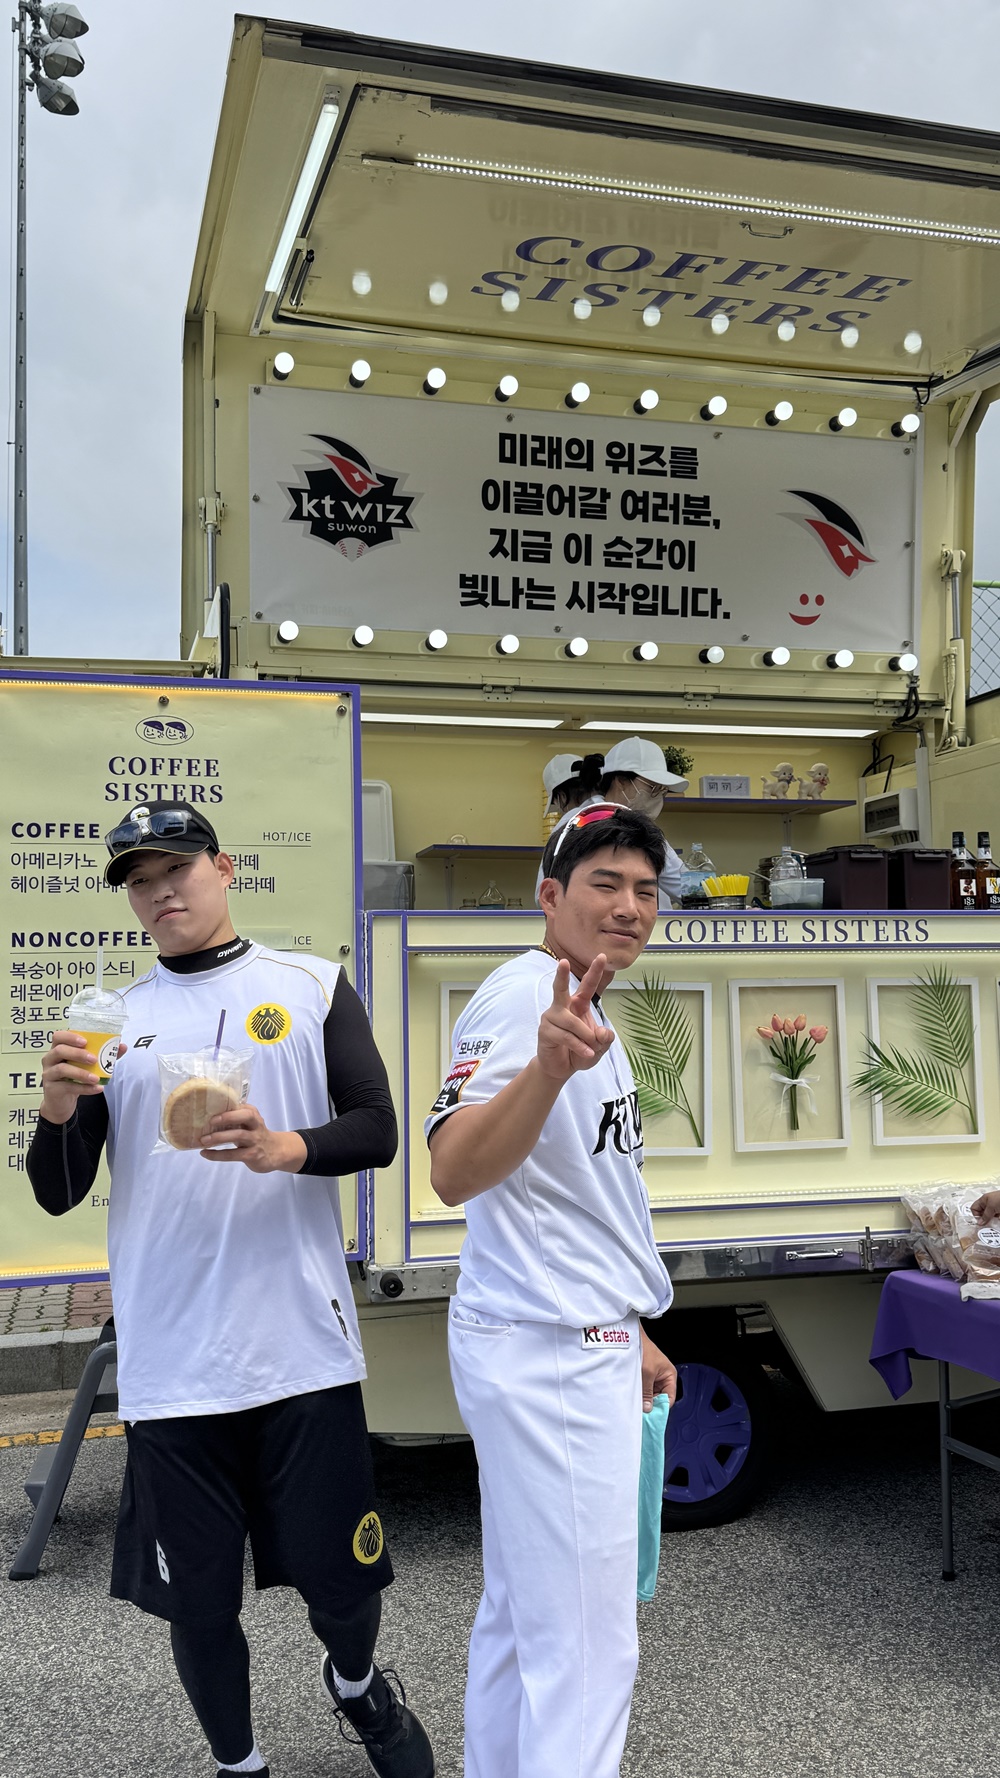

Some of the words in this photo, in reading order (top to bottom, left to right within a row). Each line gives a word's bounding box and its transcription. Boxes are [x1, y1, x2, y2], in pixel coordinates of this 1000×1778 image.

[515, 236, 913, 302] COFFEE
[470, 271, 872, 333] SISTERS
[498, 432, 594, 472] 미래의
[605, 441, 699, 480] 위즈를
[300, 492, 336, 519] kt
[481, 478, 611, 520] 이끌어갈
[620, 489, 721, 530] 여러분,
[489, 527, 552, 564] 지금
[563, 532, 592, 566] 이
[603, 535, 696, 572] 순간이
[459, 573, 556, 611] 빛나는
[565, 581, 731, 620] 시작입니다.
[108, 756, 220, 778] COFFEE
[104, 782, 224, 804] SISTERS
[11, 822, 100, 839] COFFEE
[262, 832, 312, 842] HOT/ICE
[10, 852, 98, 870] 아메리카노
[10, 875, 80, 894] 헤이즐넛
[11, 931, 153, 948] NONCOFFEE
[664, 919, 789, 943] COFFEE
[801, 918, 929, 942] SISTERS
[10, 961, 63, 980] 복숭아
[603, 1329, 630, 1342] estate
